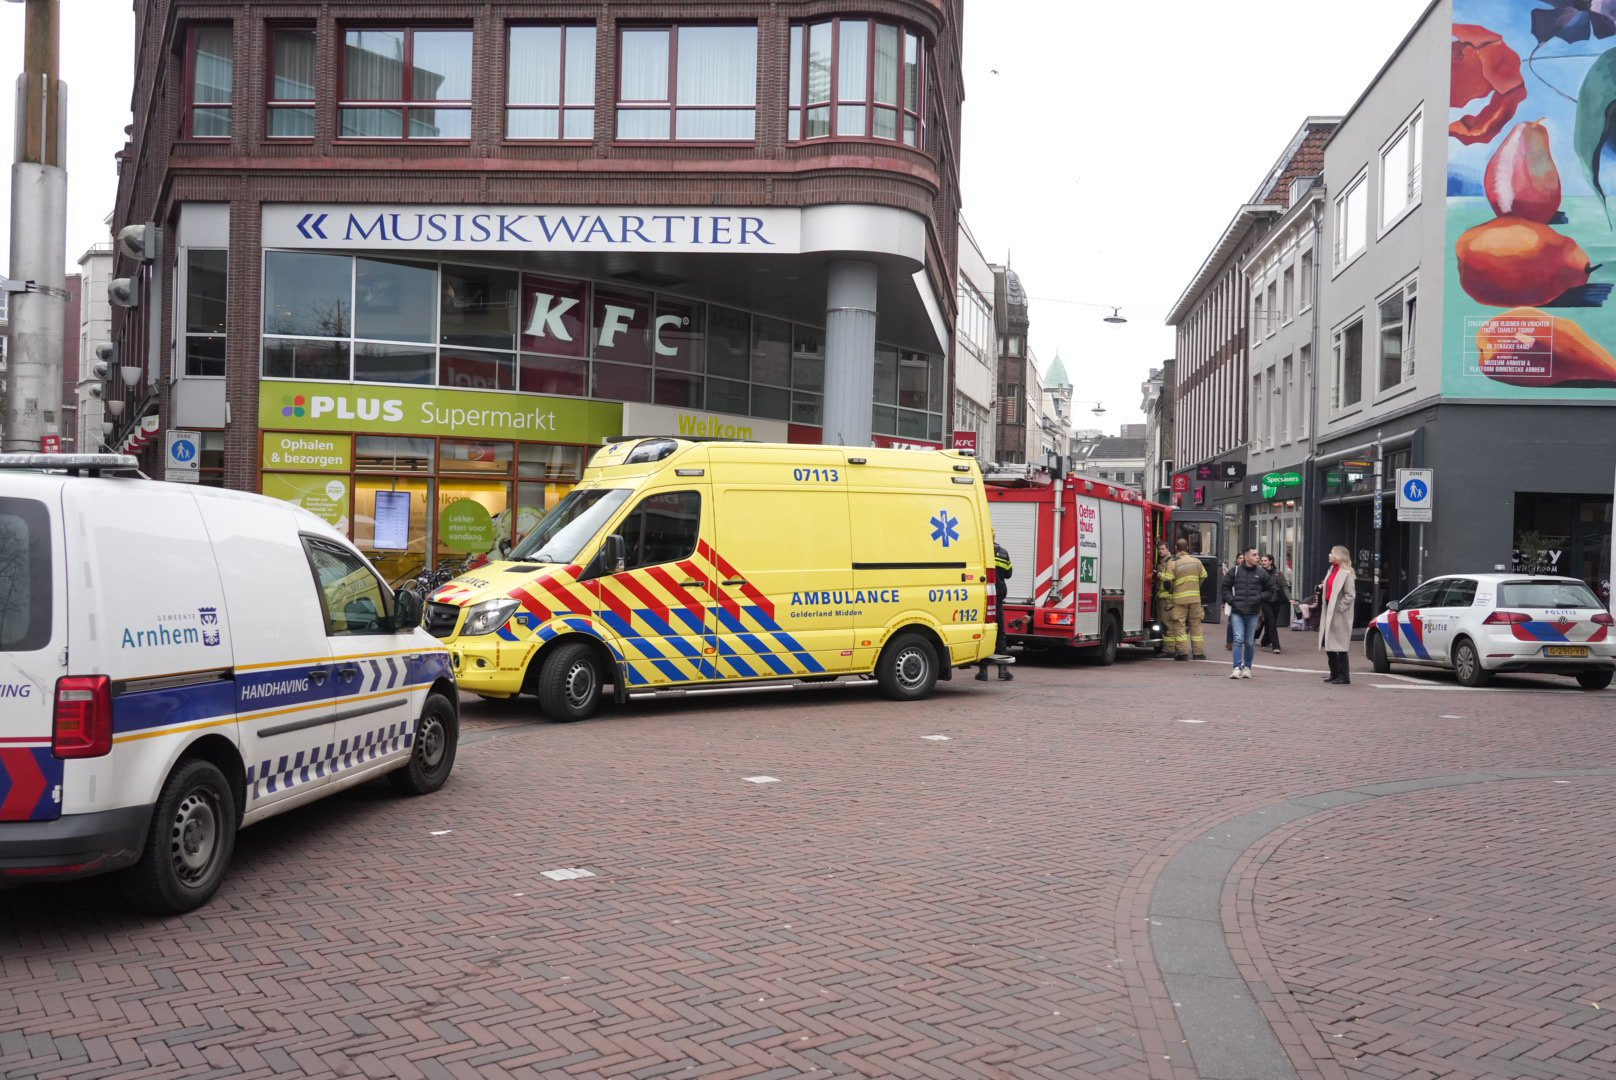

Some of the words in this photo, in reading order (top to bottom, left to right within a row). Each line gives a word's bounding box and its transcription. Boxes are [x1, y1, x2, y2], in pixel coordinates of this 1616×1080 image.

[342, 213, 775, 245] MUSISKWARTIER
[311, 396, 404, 422] PLUS
[420, 402, 556, 430] Supermarkt
[678, 415, 753, 440] Welkom
[281, 438, 334, 452] Ophalen
[271, 452, 280, 462] &
[284, 452, 343, 466] bezorgen
[794, 468, 839, 482] 07113
[1080, 504, 1096, 519] Oefen
[1080, 520, 1094, 533] thuis
[791, 590, 900, 605] AMBULANCE
[928, 588, 968, 602] 07113
[1424, 624, 1447, 632] POLITIE
[122, 624, 199, 648] Arnhem
[0, 685, 31, 697] ING
[241, 678, 308, 700] HANDHAVING
